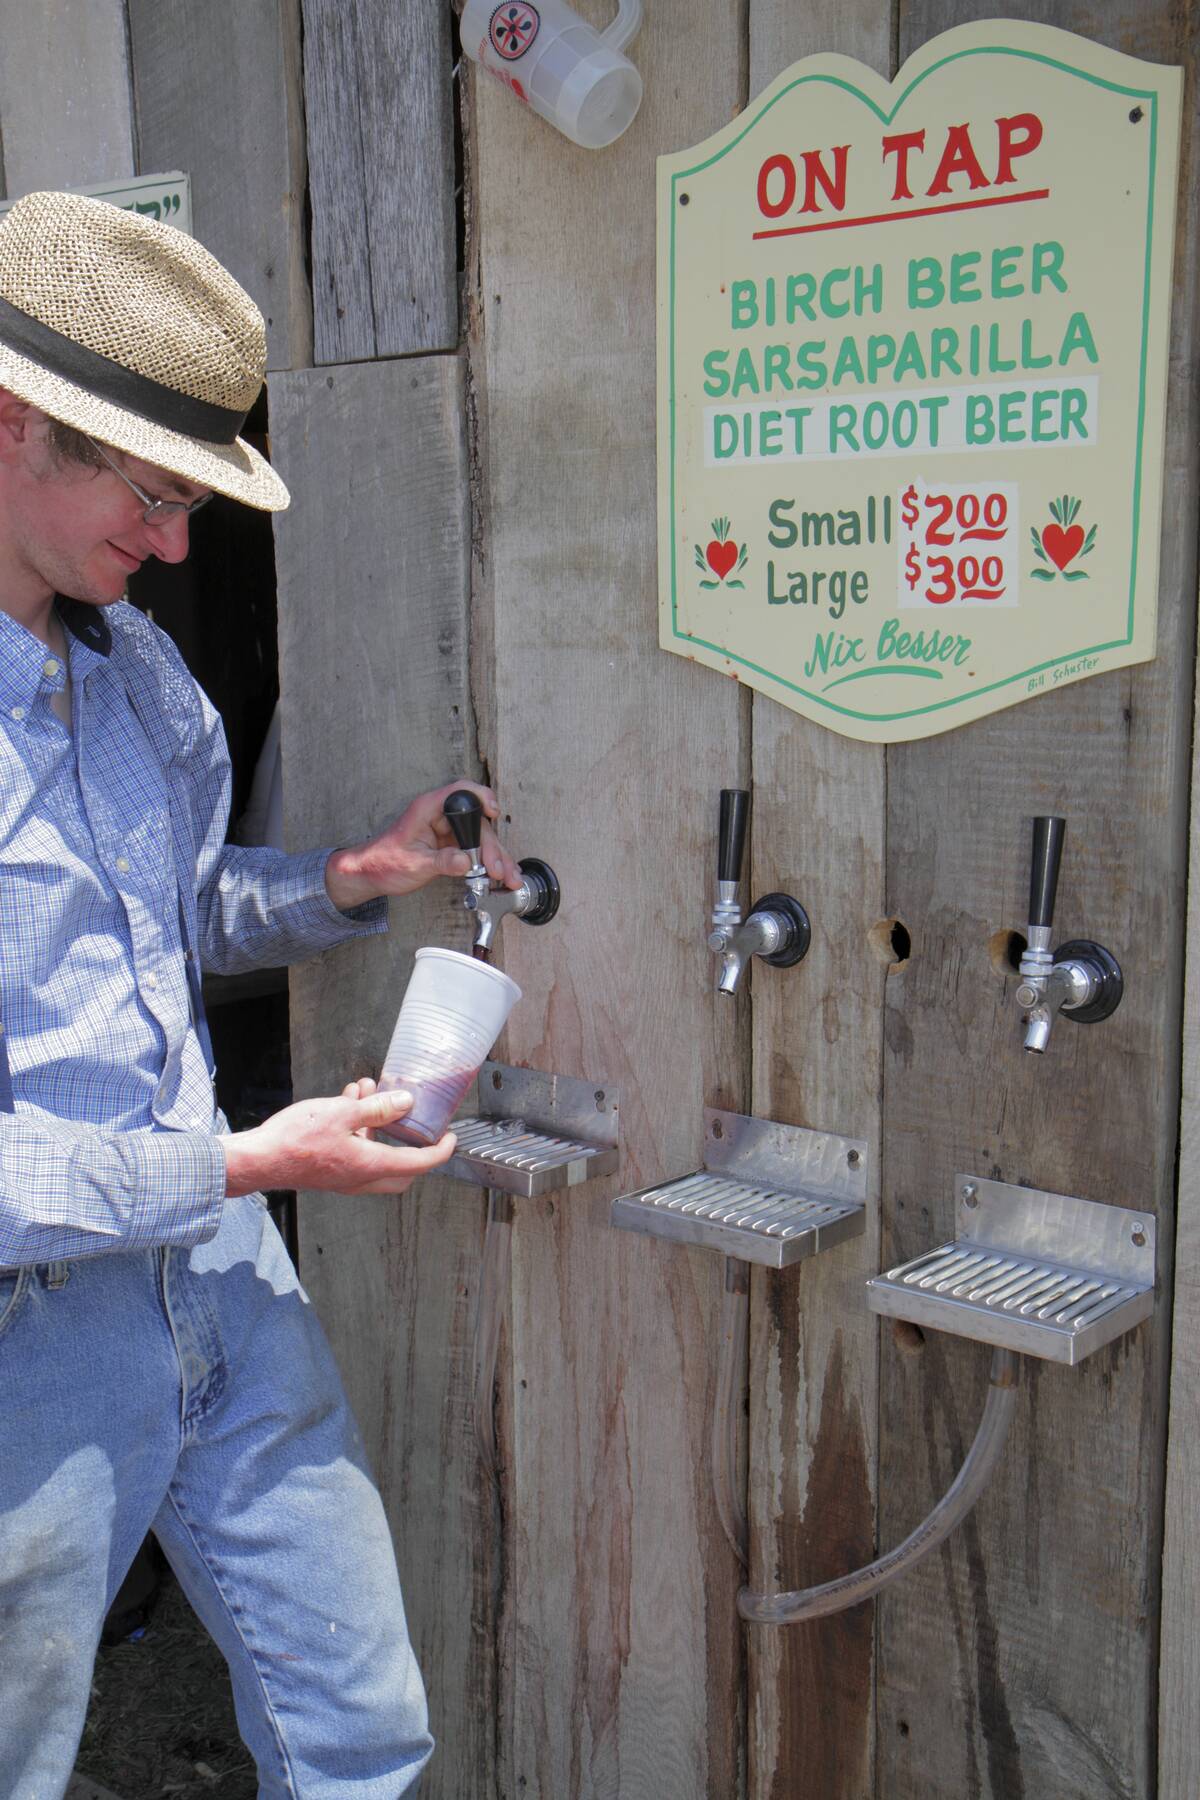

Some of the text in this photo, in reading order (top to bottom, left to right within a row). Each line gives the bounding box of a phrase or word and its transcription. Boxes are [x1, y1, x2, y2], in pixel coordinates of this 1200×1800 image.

[757, 113, 1043, 218] ON TAP
[730, 240, 1068, 330] BIRCH BEER
[703, 312, 1099, 399] SARSAPARILLA
[713, 387, 1089, 460] DIET ROOT BEER
[768, 495, 892, 549] Small
[766, 560, 869, 619] Large
[804, 618, 972, 678] Nix Besser
[1027, 656, 1100, 692] Bill Schuster
